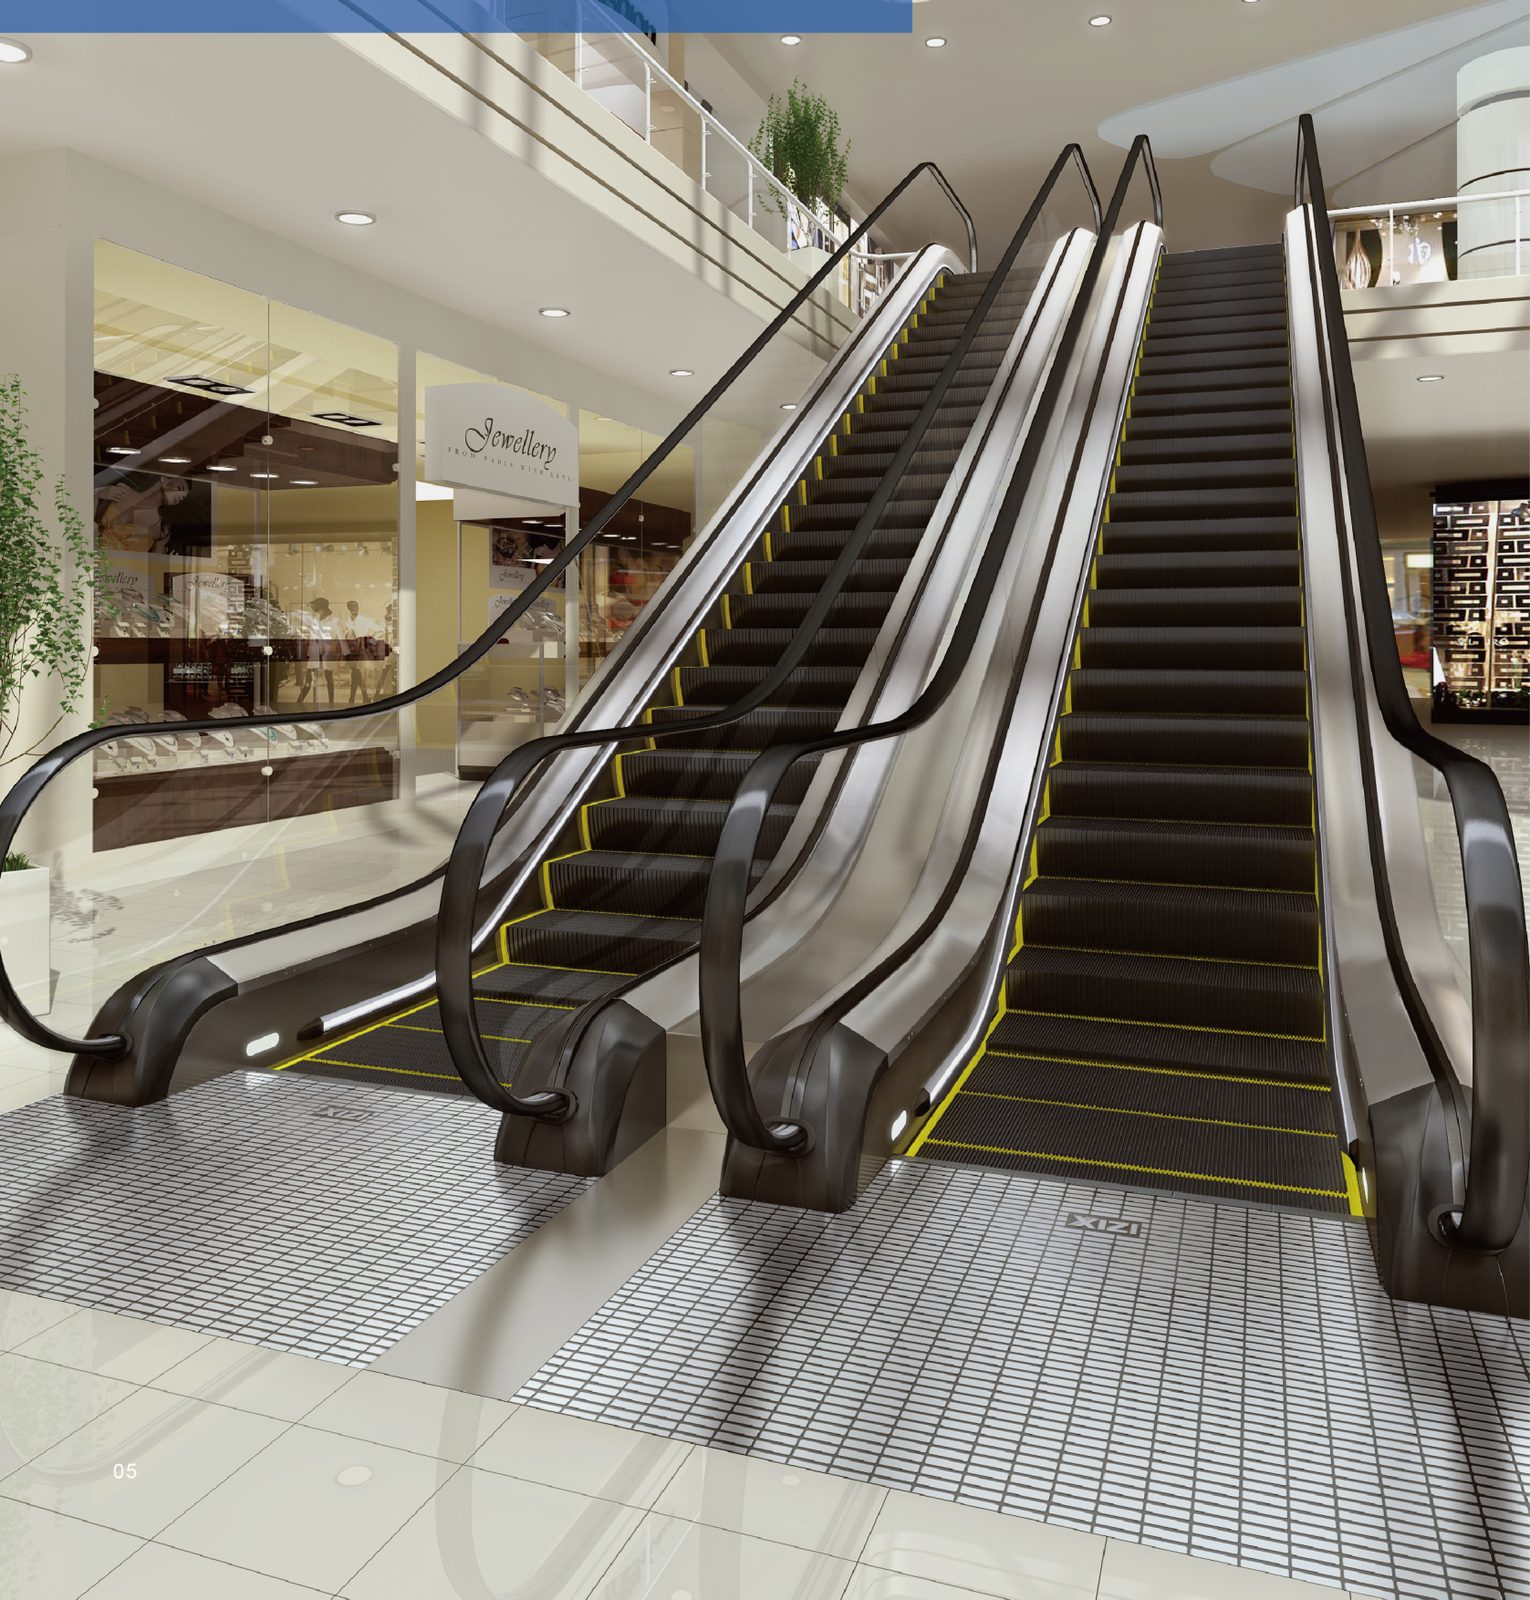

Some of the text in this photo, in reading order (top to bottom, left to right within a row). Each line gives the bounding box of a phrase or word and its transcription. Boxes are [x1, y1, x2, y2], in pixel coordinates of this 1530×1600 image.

[447, 446, 476, 459] FROM
[464, 417, 557, 471] Jewellery
[1066, 1213, 1139, 1236] XIZI
